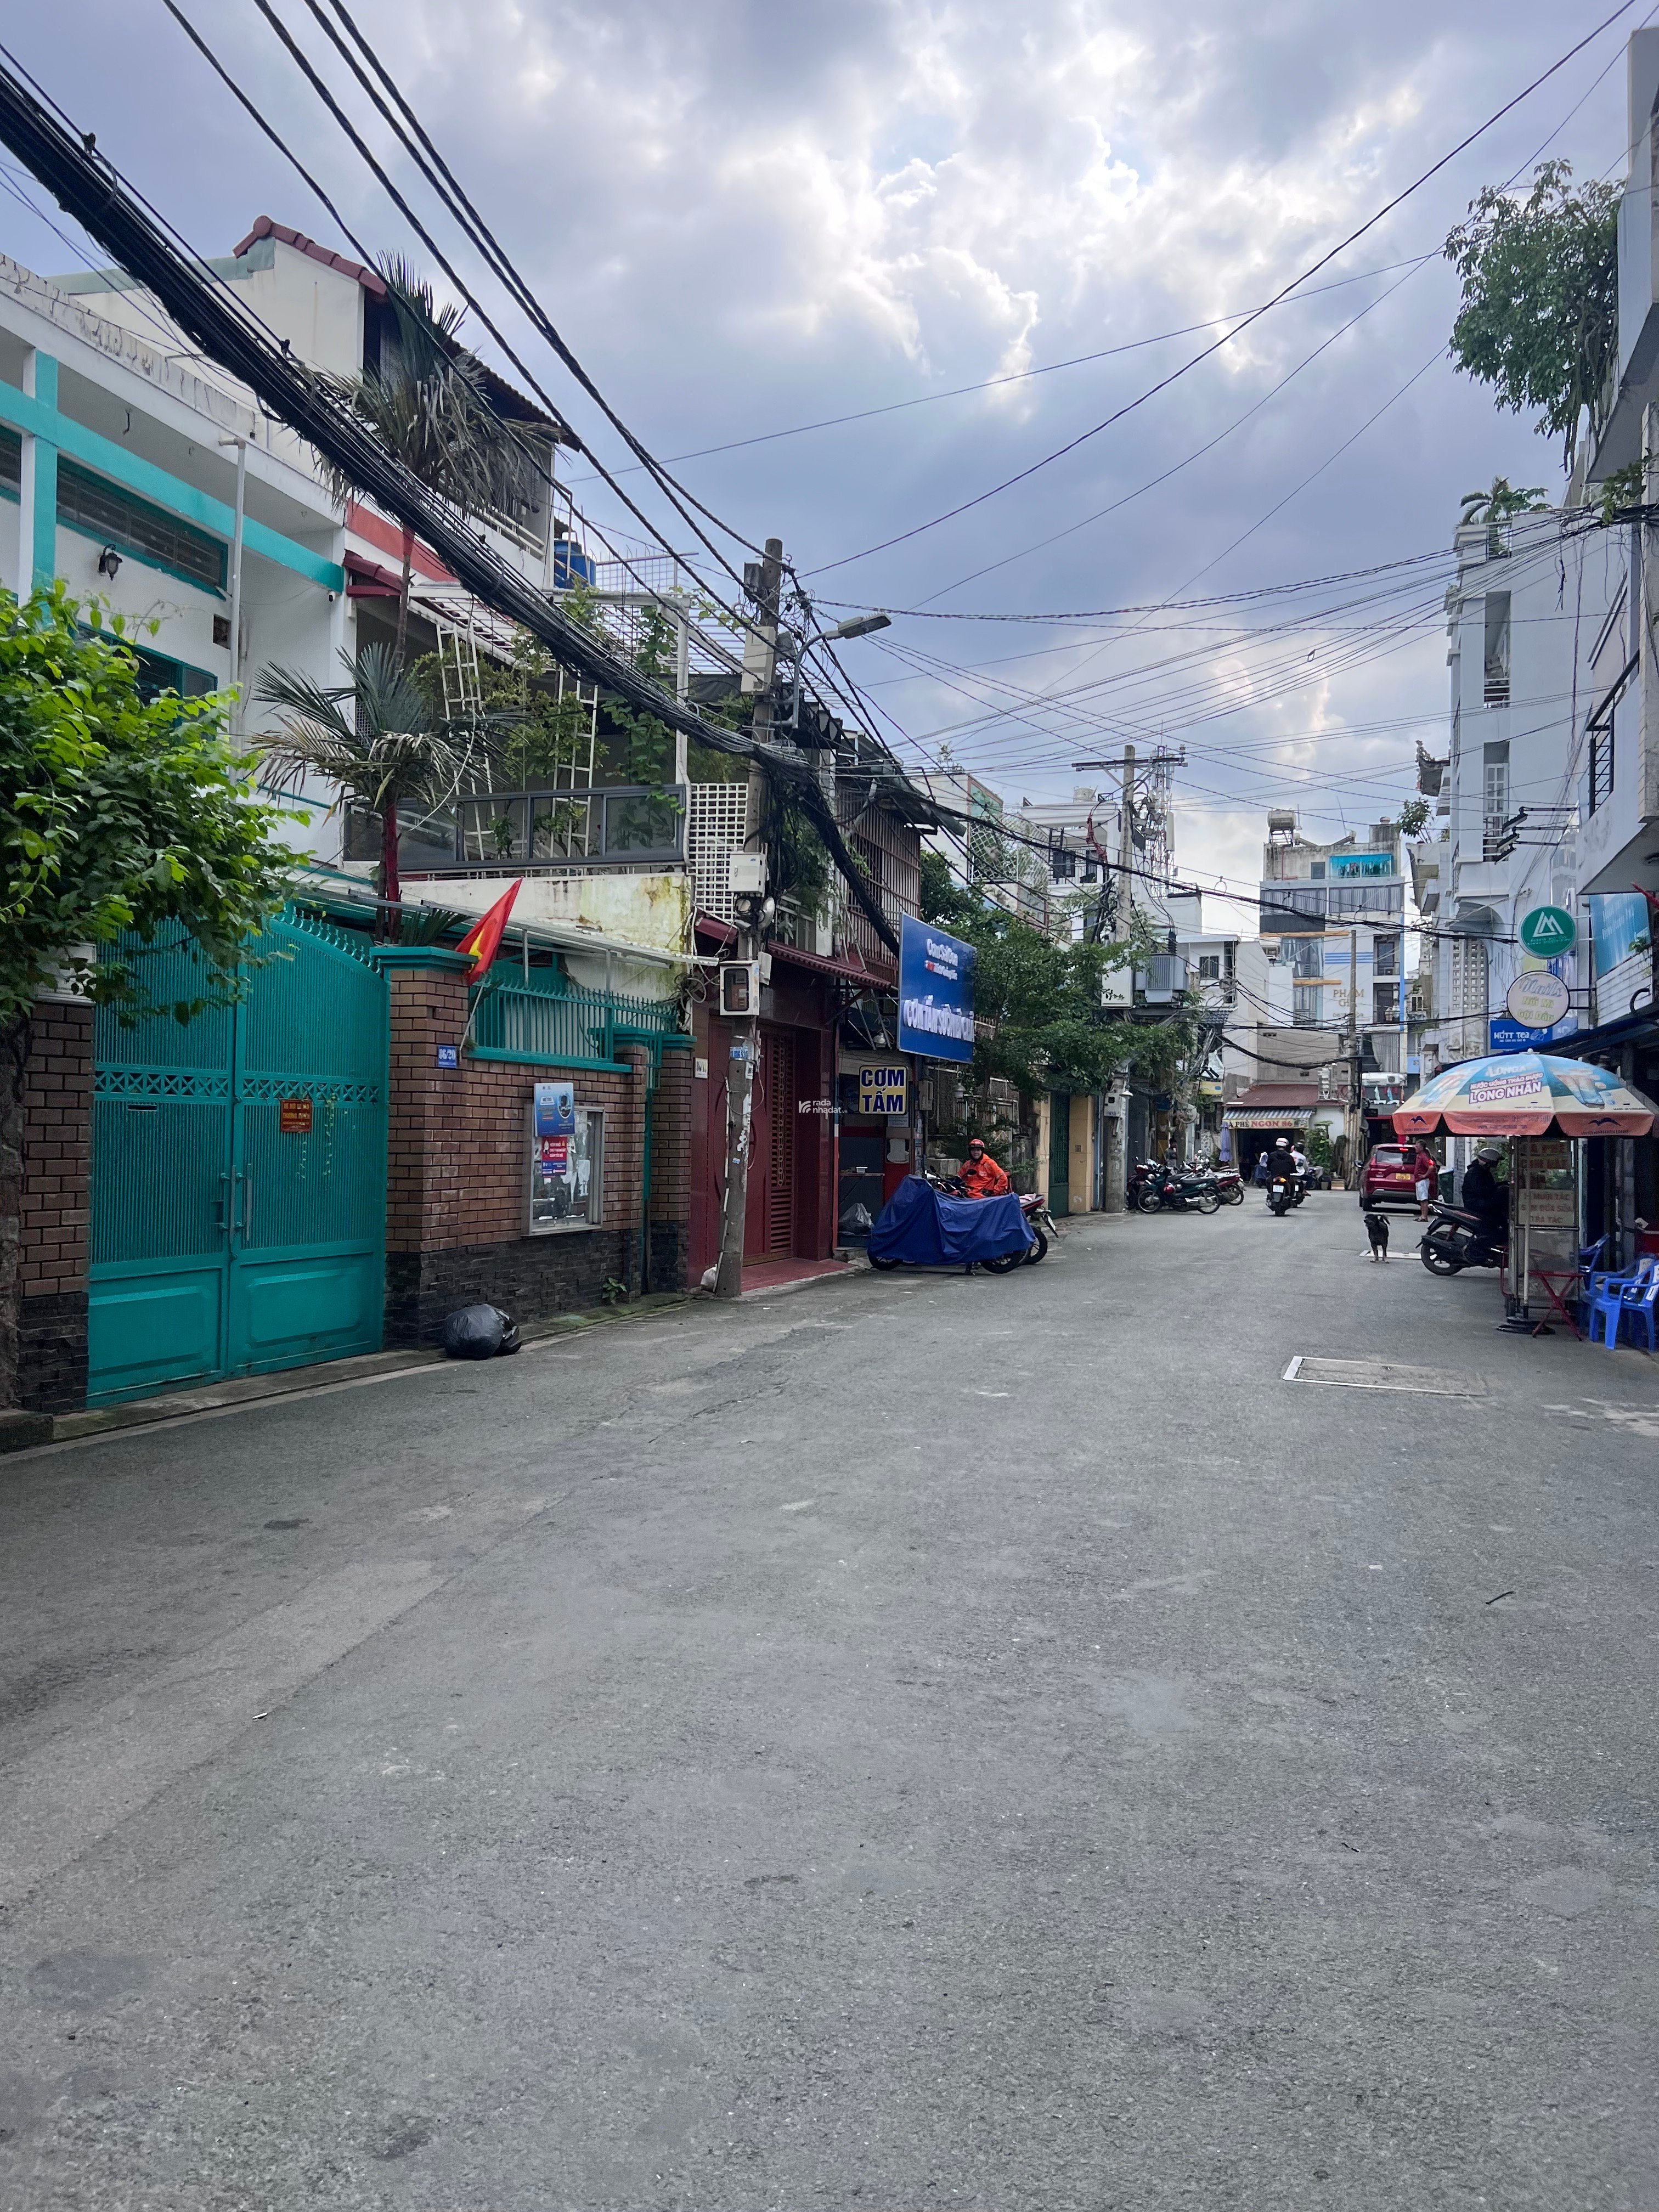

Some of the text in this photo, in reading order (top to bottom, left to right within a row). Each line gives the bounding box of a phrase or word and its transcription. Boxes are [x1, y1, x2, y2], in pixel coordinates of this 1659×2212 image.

[861, 1068, 905, 1087] CƠM
[862, 1088, 903, 1113] TẤM
[1470, 1088, 1505, 1104] LONG
